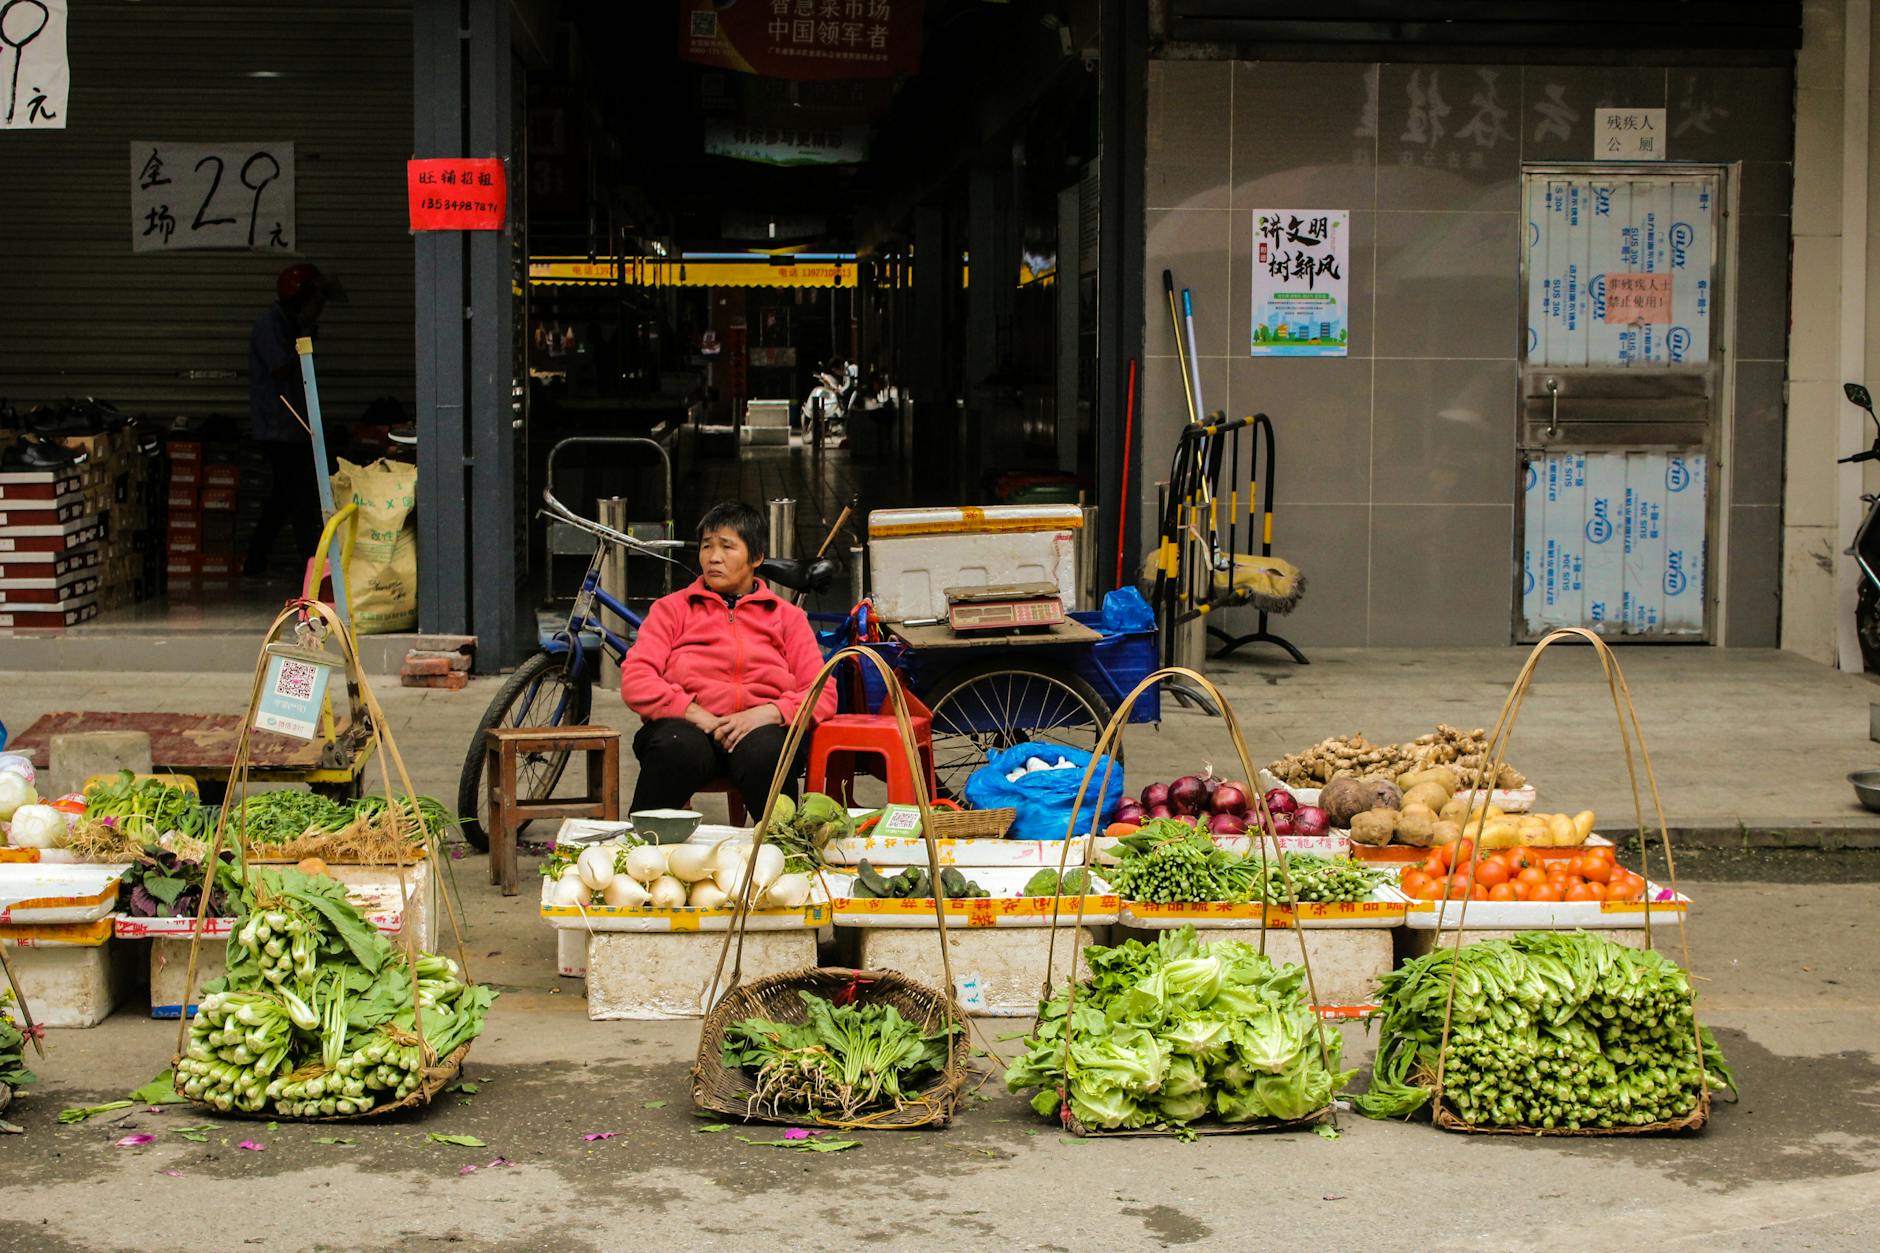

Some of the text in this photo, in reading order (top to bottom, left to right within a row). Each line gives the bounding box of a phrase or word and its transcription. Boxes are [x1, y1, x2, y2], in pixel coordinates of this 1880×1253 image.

[768, 0, 891, 21] 智慧菜市场
[767, 18, 889, 49] 中国领军者
[1607, 115, 1654, 131] 残疾人
[1260, 213, 1328, 250] 讲文明
[1268, 250, 1341, 291] 树新风
